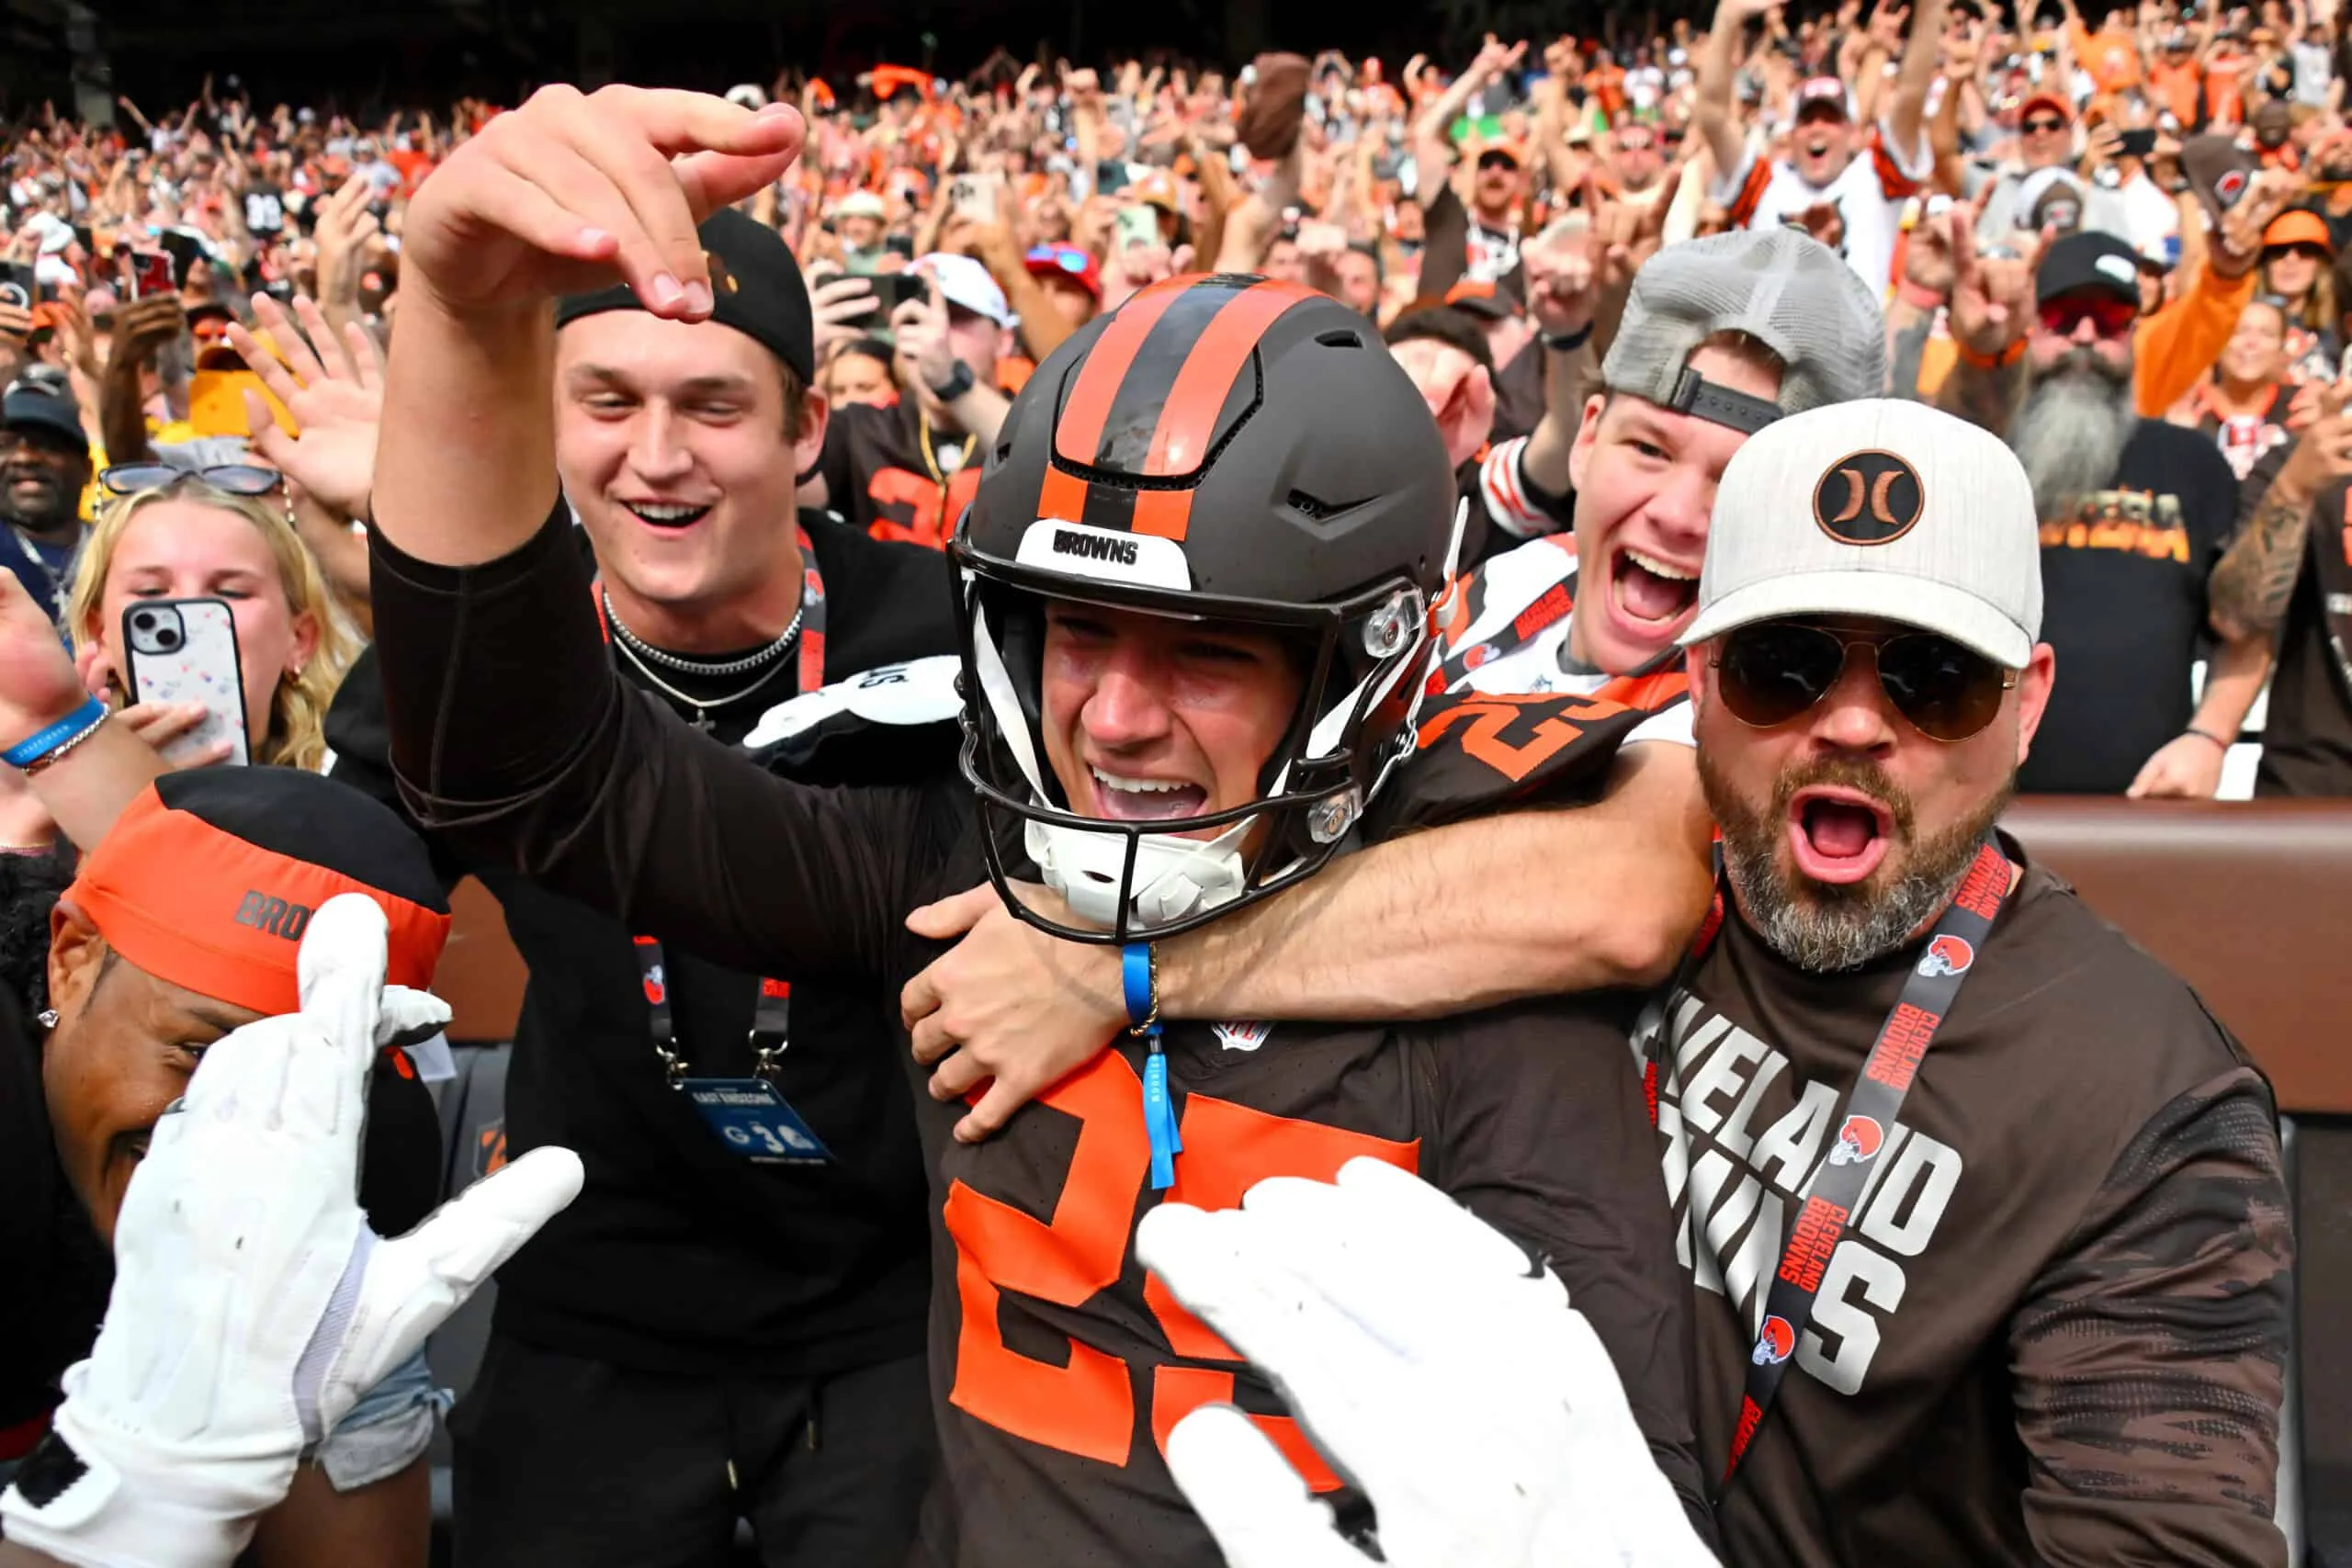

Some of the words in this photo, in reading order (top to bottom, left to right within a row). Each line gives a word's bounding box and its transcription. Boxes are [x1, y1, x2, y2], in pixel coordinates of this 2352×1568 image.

[1053, 528, 1139, 566] BROWNS
[235, 888, 316, 942] BRO
[1866, 1001, 1923, 1086] BROWNS
[1889, 1013, 1940, 1092] CLEVELAND
[1779, 1194, 1832, 1285] BROWNS
[1799, 1204, 1849, 1294] CLEVELAND
